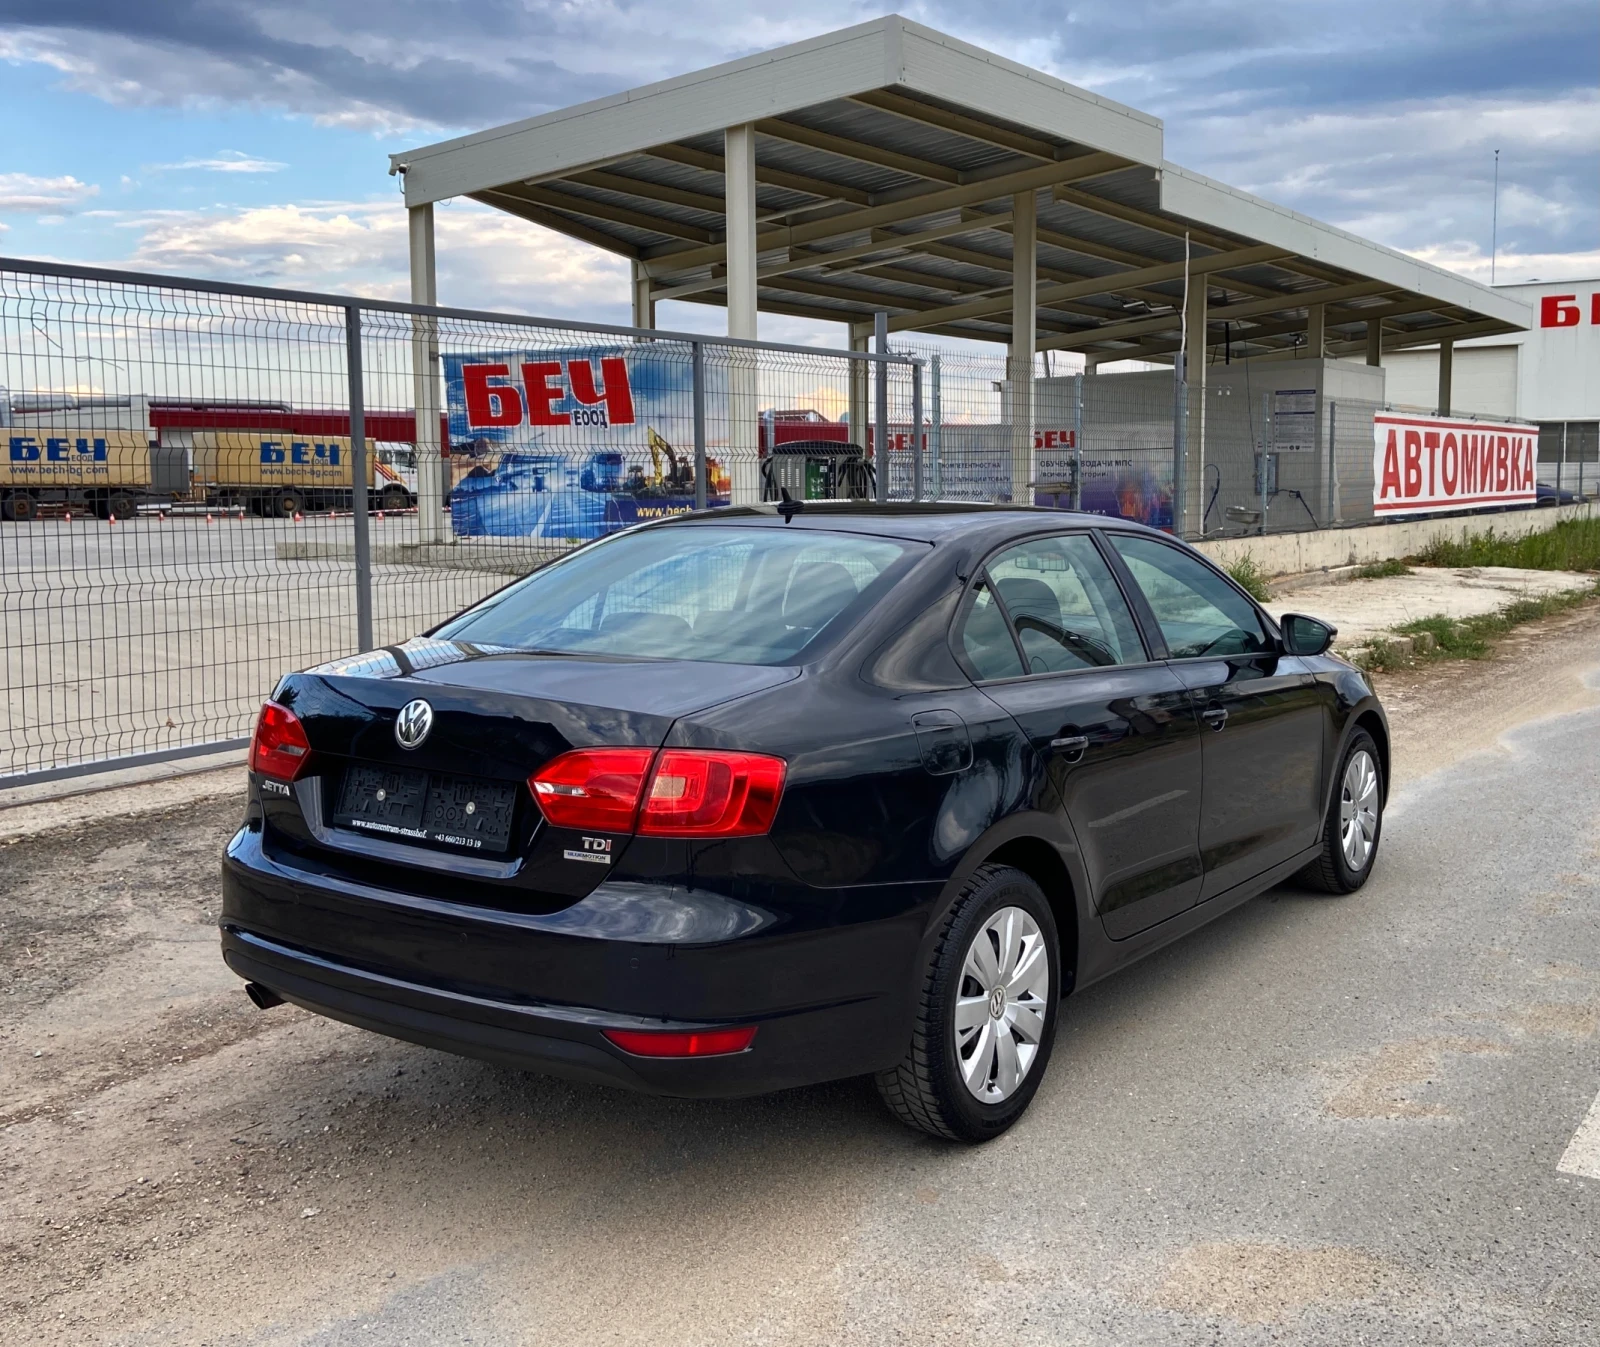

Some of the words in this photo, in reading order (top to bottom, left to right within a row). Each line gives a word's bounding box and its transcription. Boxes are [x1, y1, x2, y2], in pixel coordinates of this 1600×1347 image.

[1540, 293, 1600, 328] Б
[462, 357, 635, 428] БЕЧ
[574, 410, 608, 428] ЕООД
[9, 437, 106, 462] БЕЧ
[260, 441, 340, 466] БЕЧ
[9, 465, 109, 476] www.bech-bg.com
[1114, 459, 1133, 467] МПС
[1380, 428, 1534, 499] АВТОМИВКА
[260, 467, 342, 477] www.bech-bg.com
[261, 779, 290, 796] JETTA
[434, 833, 445, 842] +43
[466, 838, 474, 847] 13
[474, 839, 482, 848] 19
[581, 836, 612, 851] TDI
